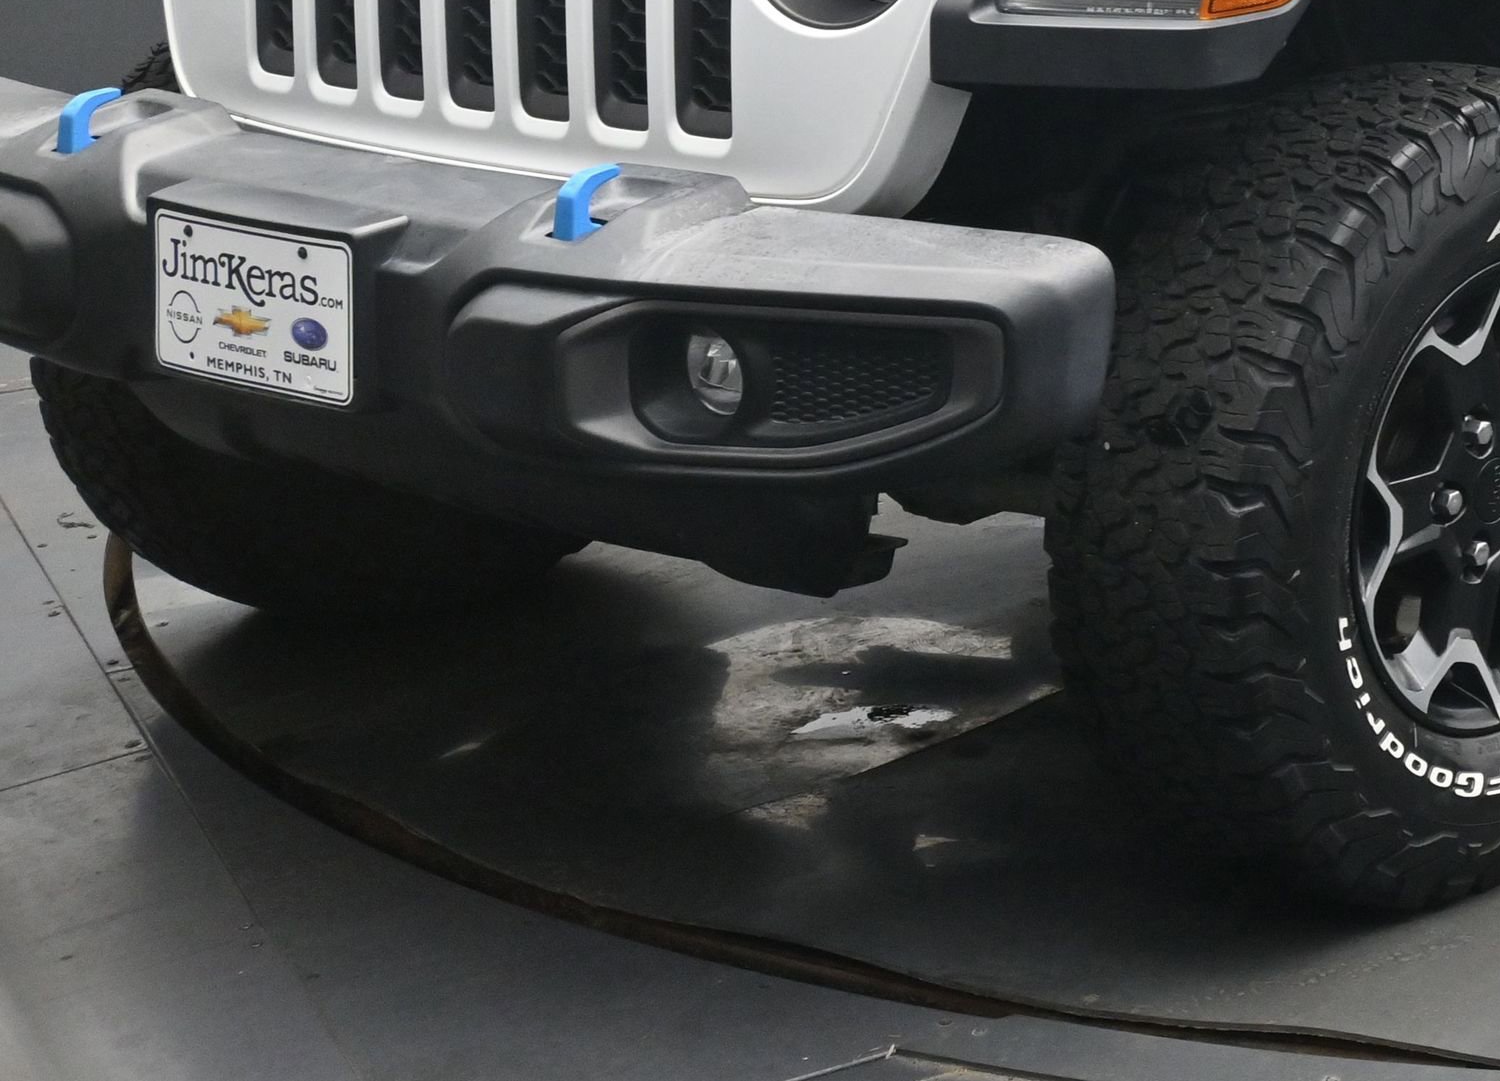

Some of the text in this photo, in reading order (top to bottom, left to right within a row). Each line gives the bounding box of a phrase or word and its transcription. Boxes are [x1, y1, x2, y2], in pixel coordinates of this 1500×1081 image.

[166, 309, 203, 325] NISSAN
[218, 341, 268, 358] CHEVROLET
[206, 356, 292, 384] MEMPHIS, TN
[283, 350, 337, 371] SUBARU
